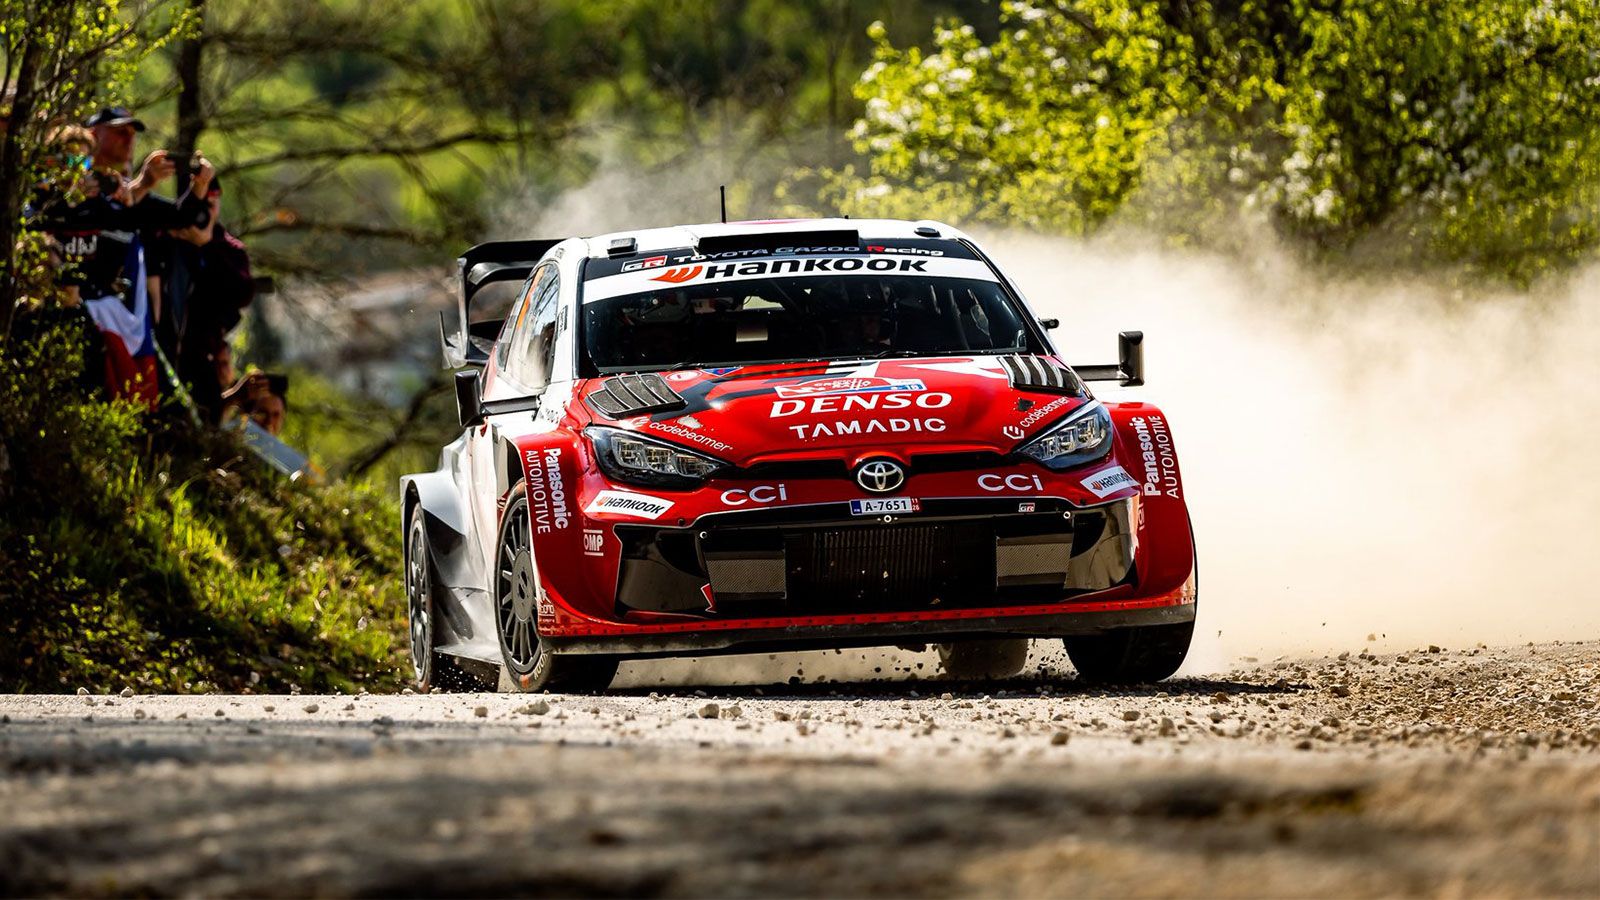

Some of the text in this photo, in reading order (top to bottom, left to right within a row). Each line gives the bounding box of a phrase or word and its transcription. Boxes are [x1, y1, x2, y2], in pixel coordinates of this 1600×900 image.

[624, 257, 666, 271] GR
[673, 248, 769, 263] TOYOTA
[774, 245, 861, 254] GAZOO
[769, 391, 953, 419] DENSO
[1019, 396, 1070, 428] codebeamer
[648, 421, 731, 453] codebeamer
[789, 417, 947, 440] TAMADIC
[1128, 416, 1162, 497] Panasonic
[1147, 415, 1180, 499] AUTOMOTIVE
[525, 450, 551, 535] AUTOMOTIVE
[543, 447, 572, 530] Panasonic
[864, 499, 908, 512] A-7651
[583, 533, 604, 552] OMP
